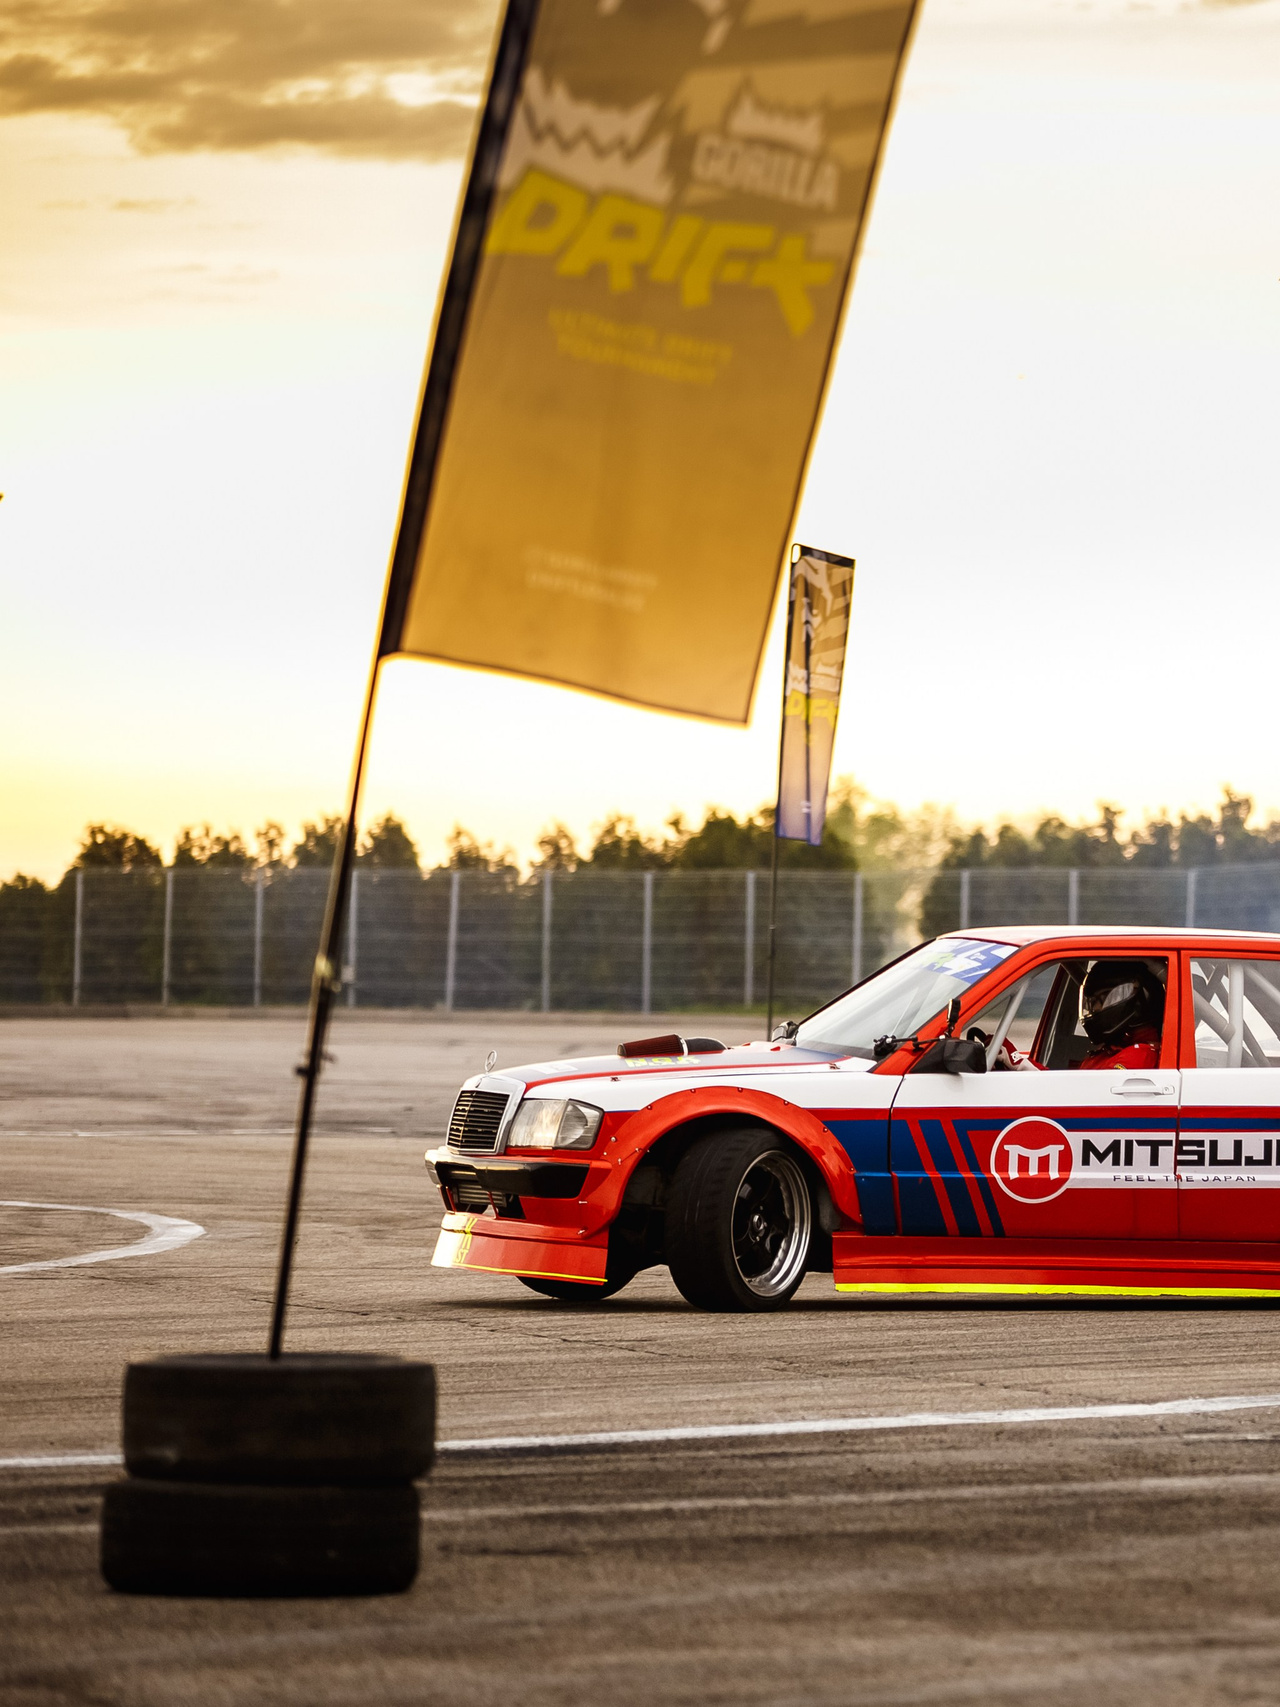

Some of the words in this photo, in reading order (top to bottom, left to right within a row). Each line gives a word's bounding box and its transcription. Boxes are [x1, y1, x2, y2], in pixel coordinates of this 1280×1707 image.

[691, 134, 839, 212] GORILLA
[485, 167, 837, 341] DRIFT
[1112, 1174, 1156, 1182] FEEL
[1162, 1174, 1195, 1182] THE
[1201, 1175, 1256, 1183] JAPAN
